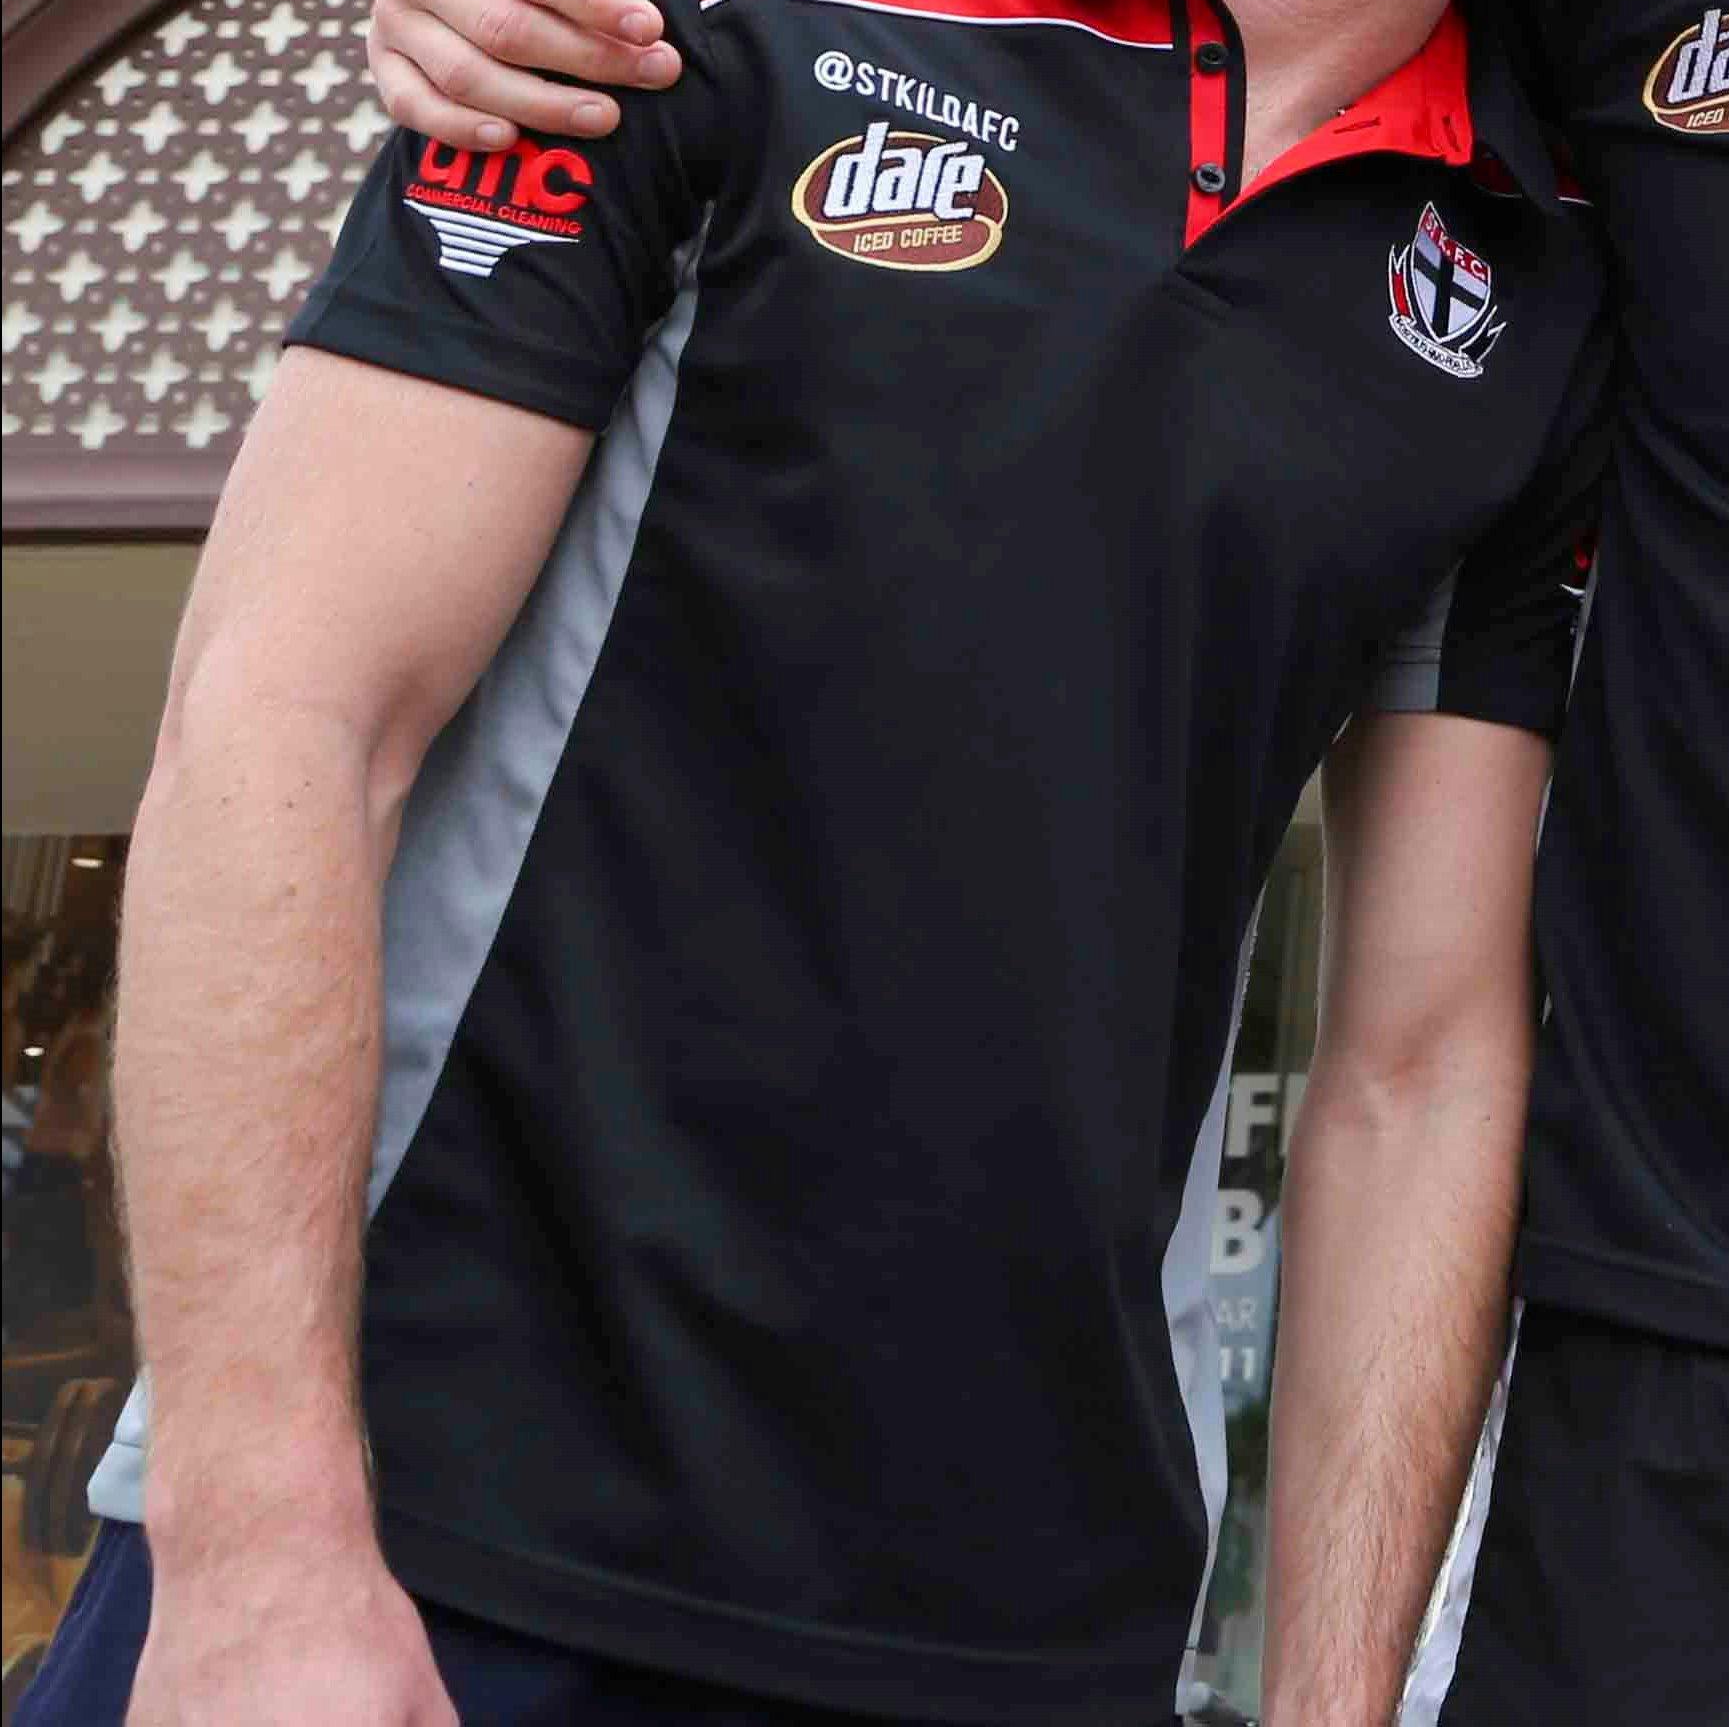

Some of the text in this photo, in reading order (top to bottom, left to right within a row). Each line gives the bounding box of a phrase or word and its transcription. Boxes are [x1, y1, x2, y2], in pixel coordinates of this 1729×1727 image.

[813, 50, 1021, 152] @STKILDAFC
[1686, 107, 1724, 129] ICED
[823, 121, 986, 220] dare
[853, 223, 963, 253] ICED COFFEE
